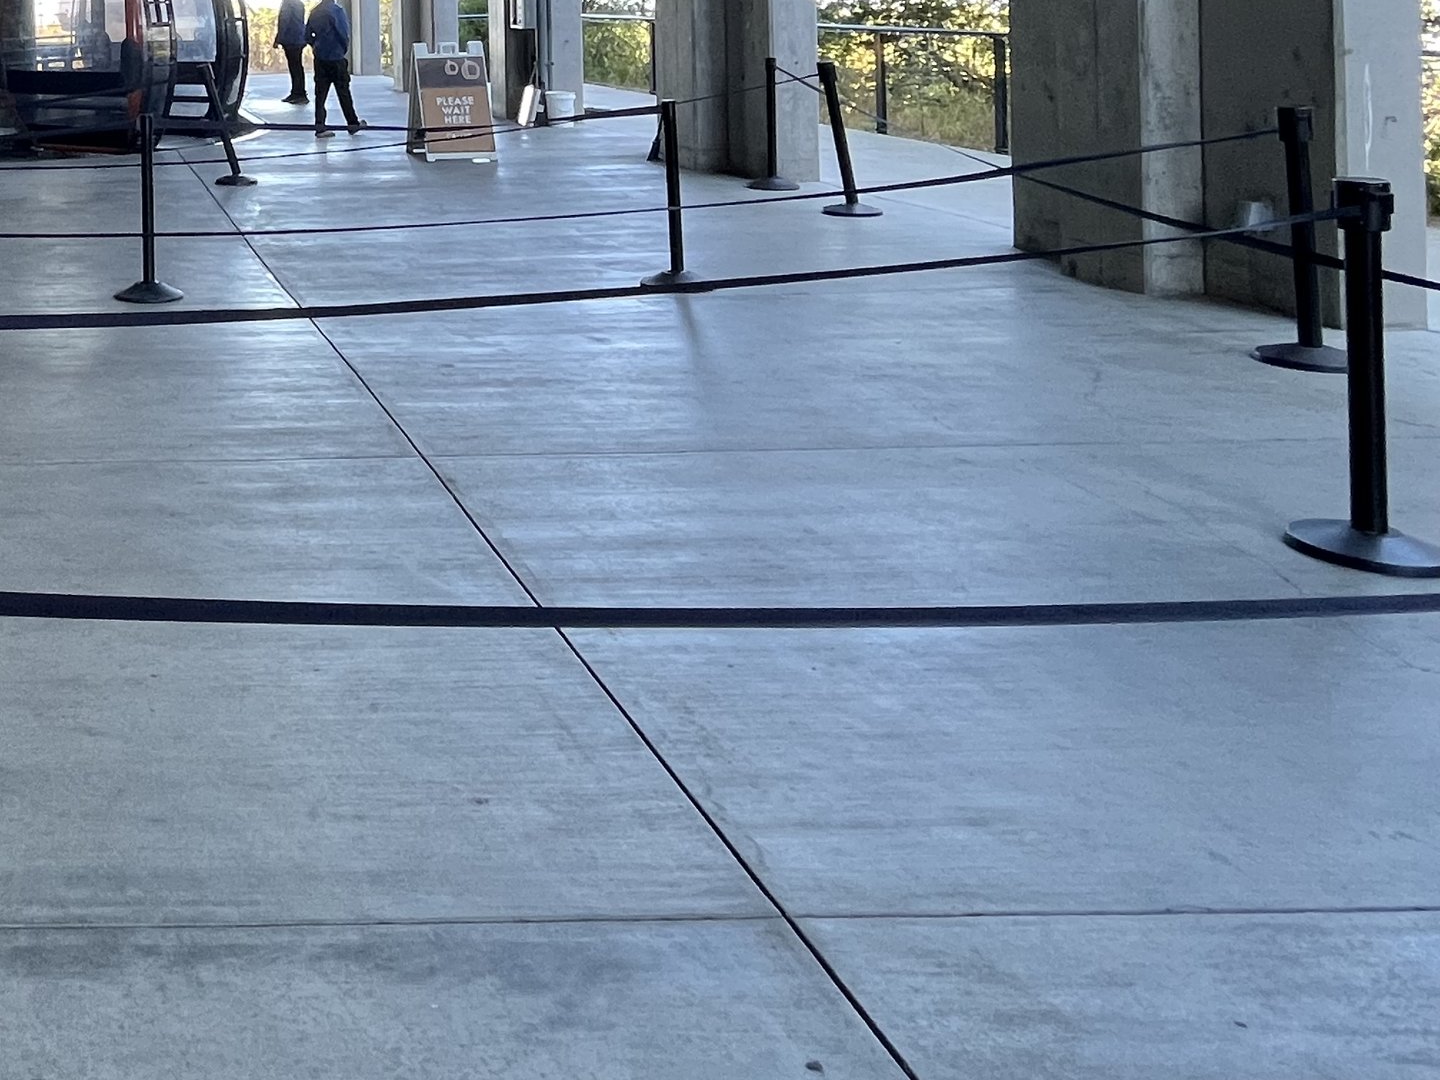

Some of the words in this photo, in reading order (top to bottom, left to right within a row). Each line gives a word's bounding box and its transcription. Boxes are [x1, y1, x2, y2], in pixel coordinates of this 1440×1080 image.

[435, 96, 474, 106] PLEASE
[441, 106, 470, 115] WAIT
[444, 115, 472, 124] HERE
